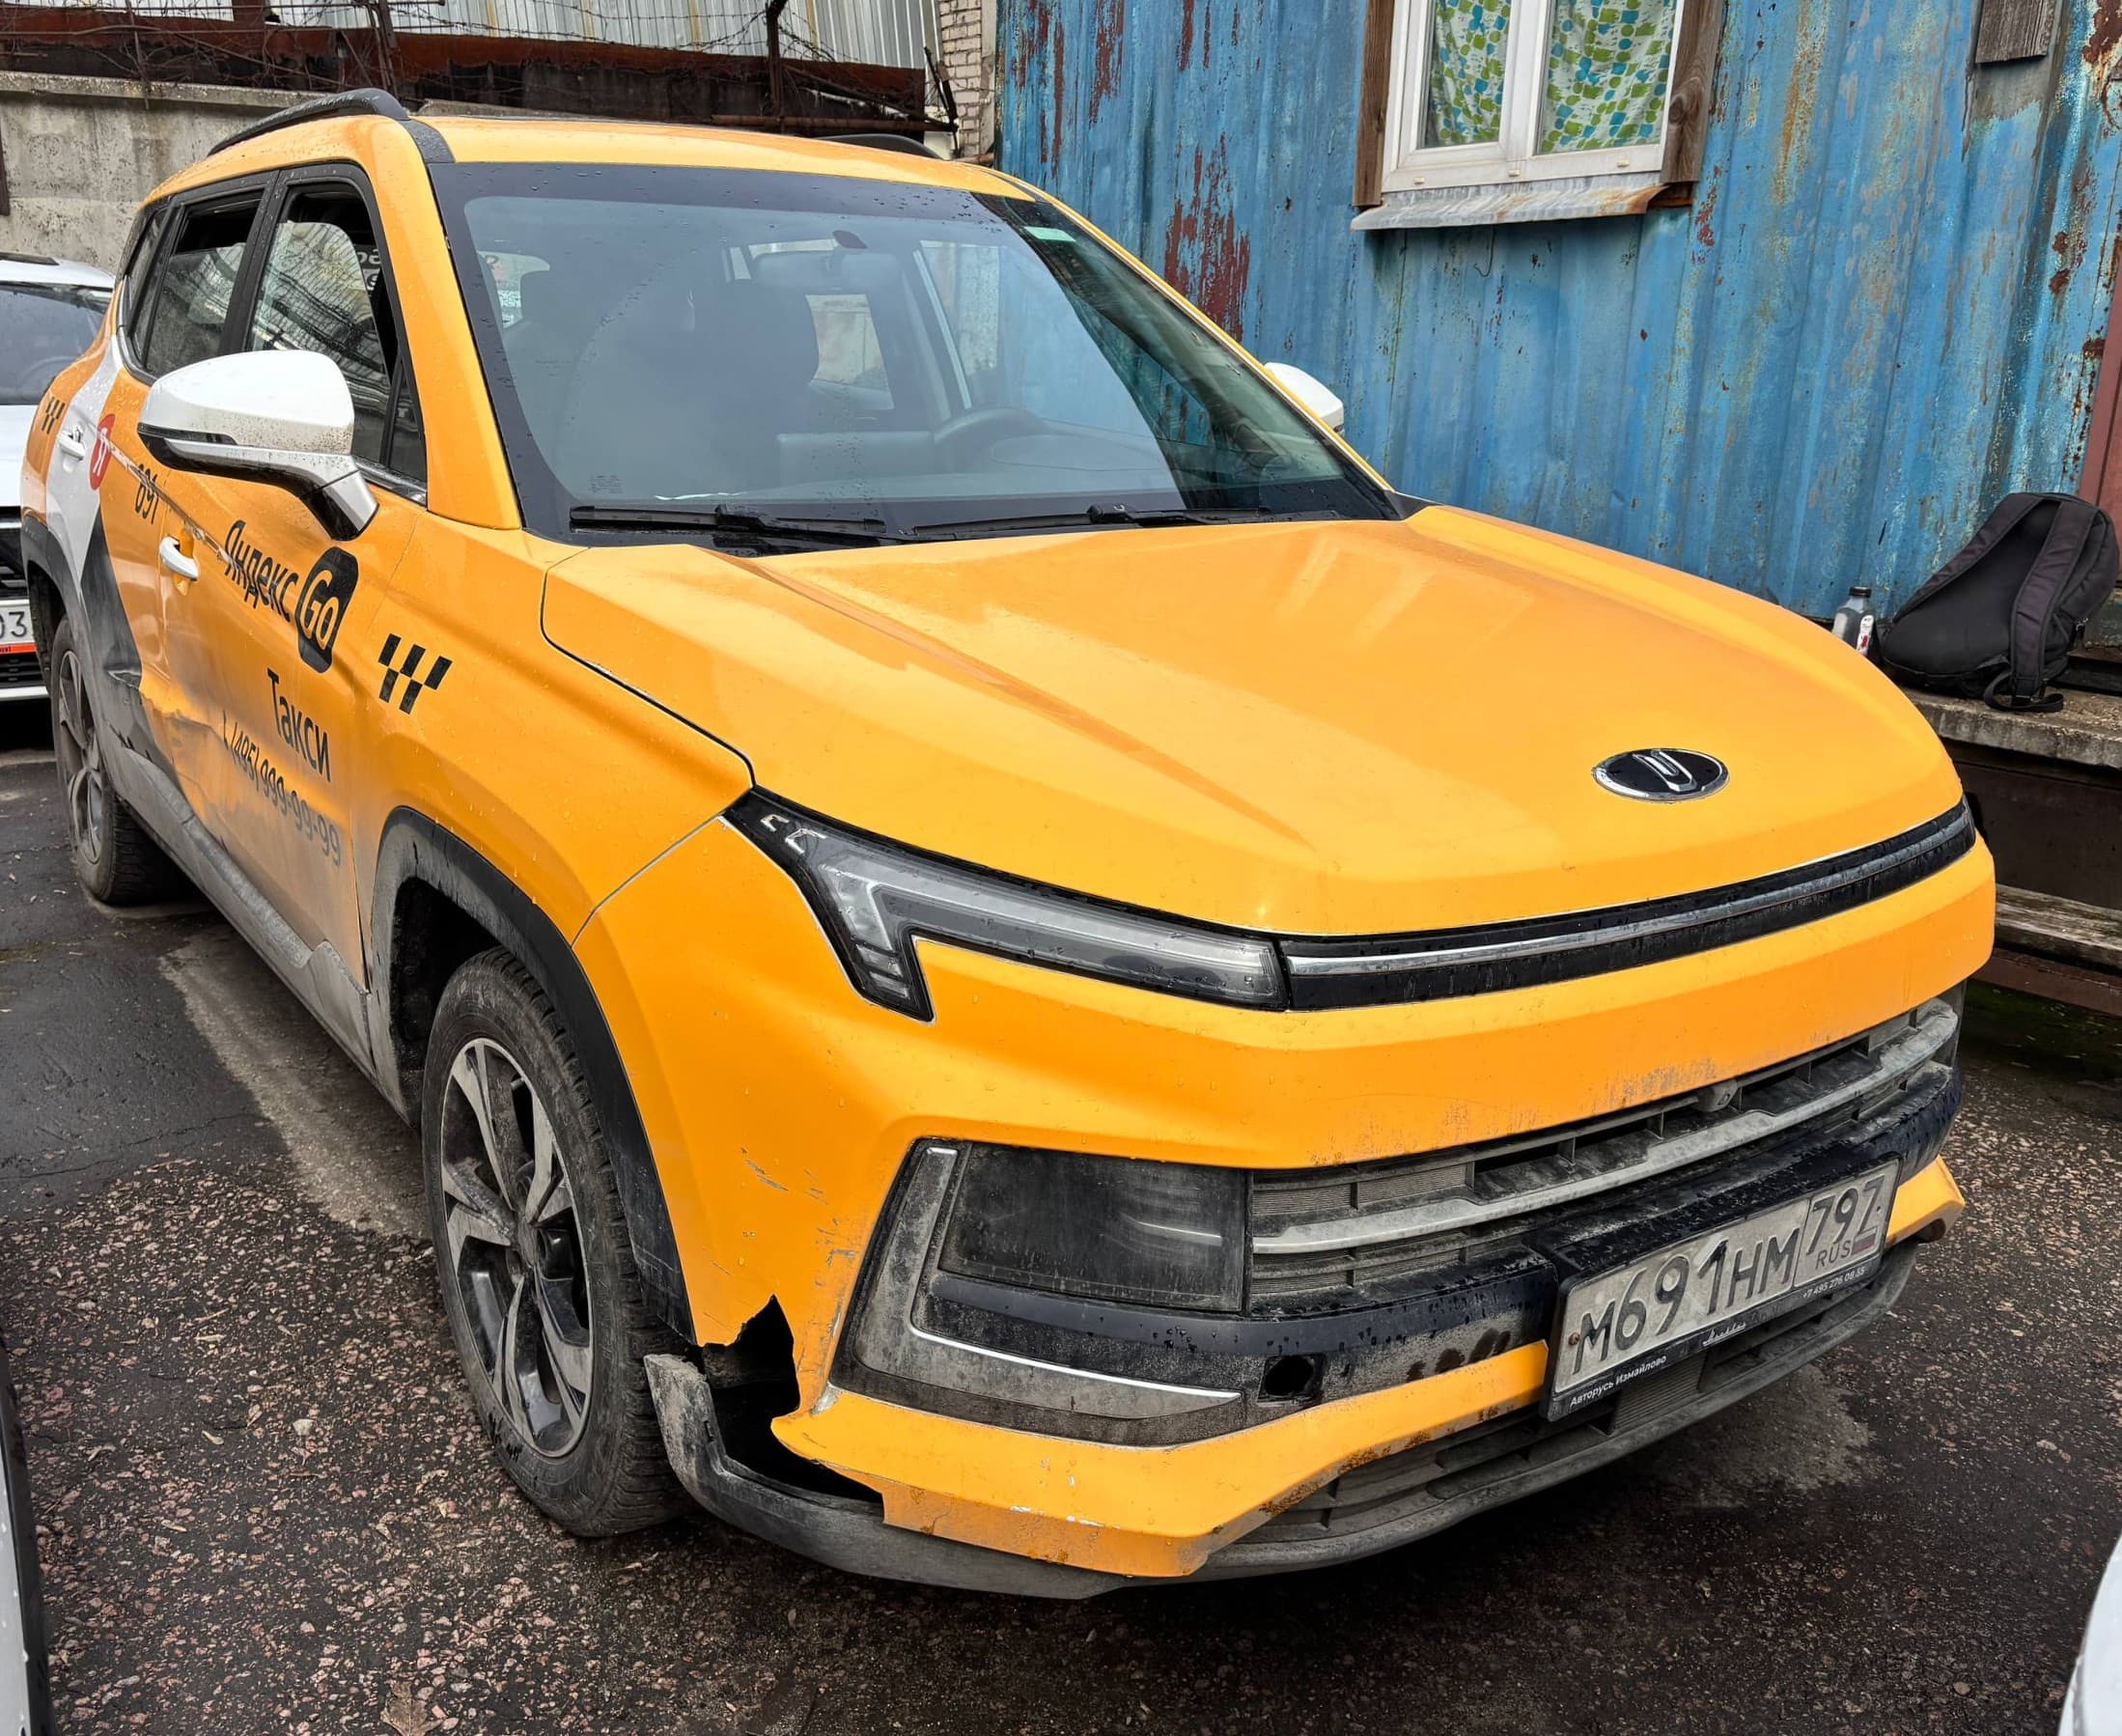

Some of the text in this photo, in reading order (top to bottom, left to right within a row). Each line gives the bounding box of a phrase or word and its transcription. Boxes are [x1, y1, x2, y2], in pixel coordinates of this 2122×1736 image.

[224, 519, 340, 651] Яндекс Go
[266, 667, 331, 783] Такси
[260, 758, 342, 867] 999-99-99
[1815, 1240, 1852, 1270] RUS
[1570, 1355, 1667, 1408] Авторусь Измайлово
